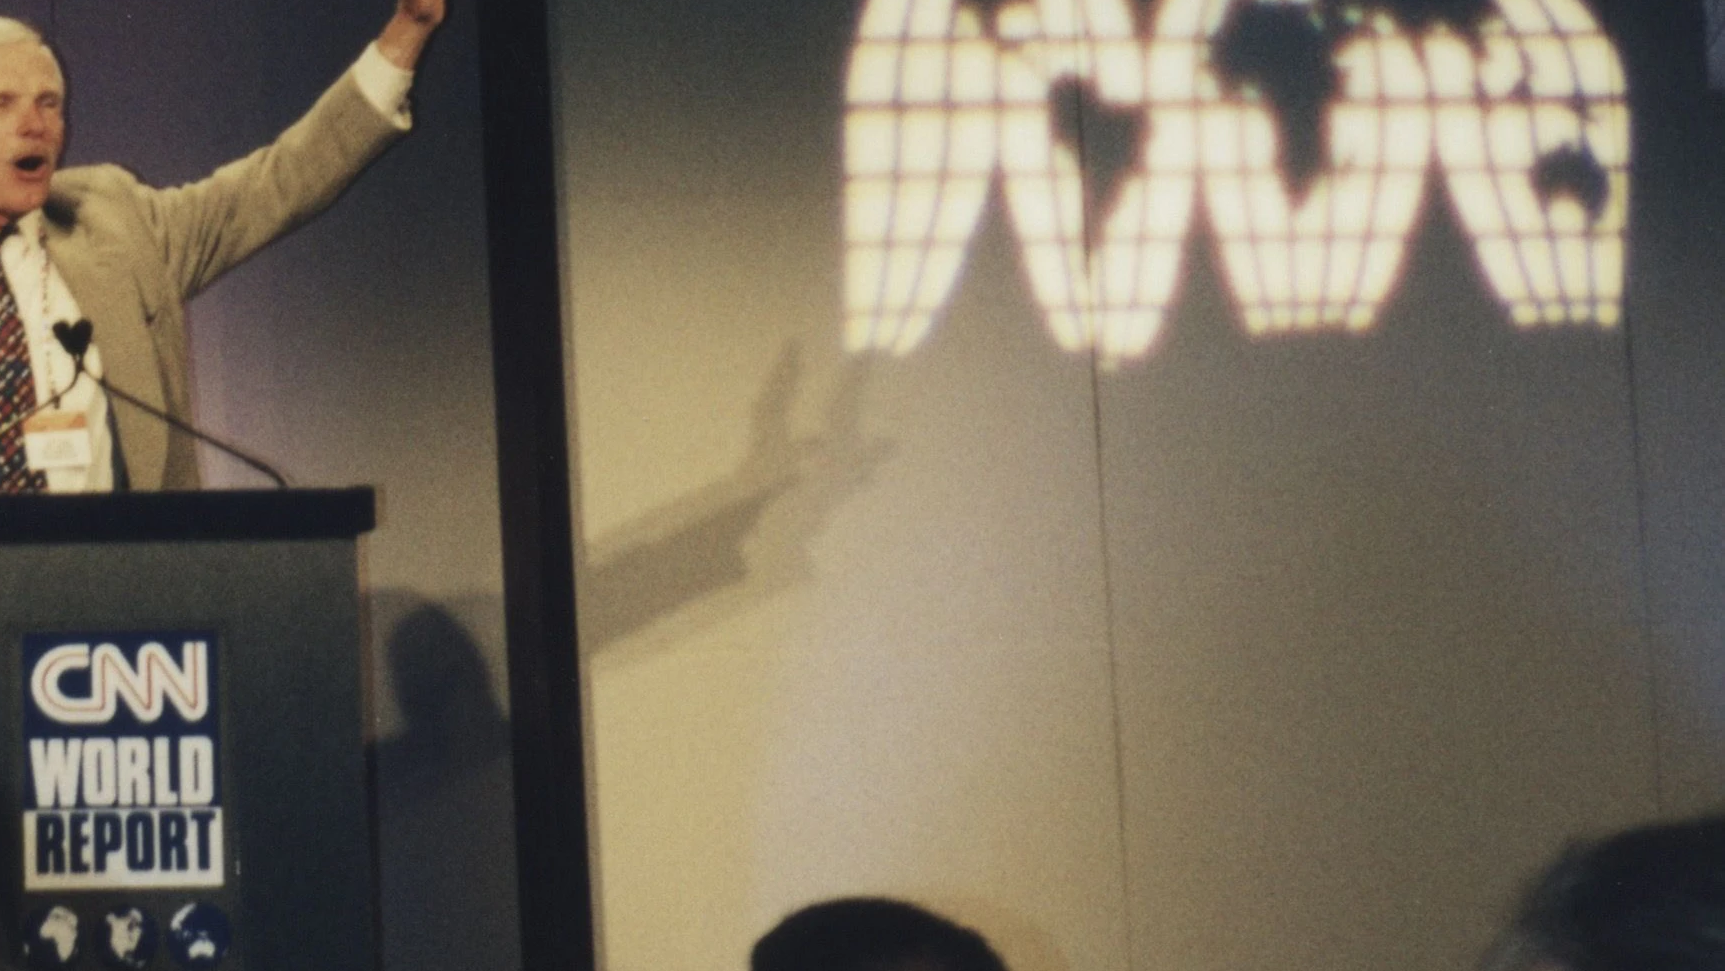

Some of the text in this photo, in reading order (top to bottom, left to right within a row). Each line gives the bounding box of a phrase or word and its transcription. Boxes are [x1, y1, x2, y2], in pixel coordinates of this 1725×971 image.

[31, 641, 208, 723] CNN
[29, 736, 214, 807] WORLD
[35, 810, 215, 874] REPORT
